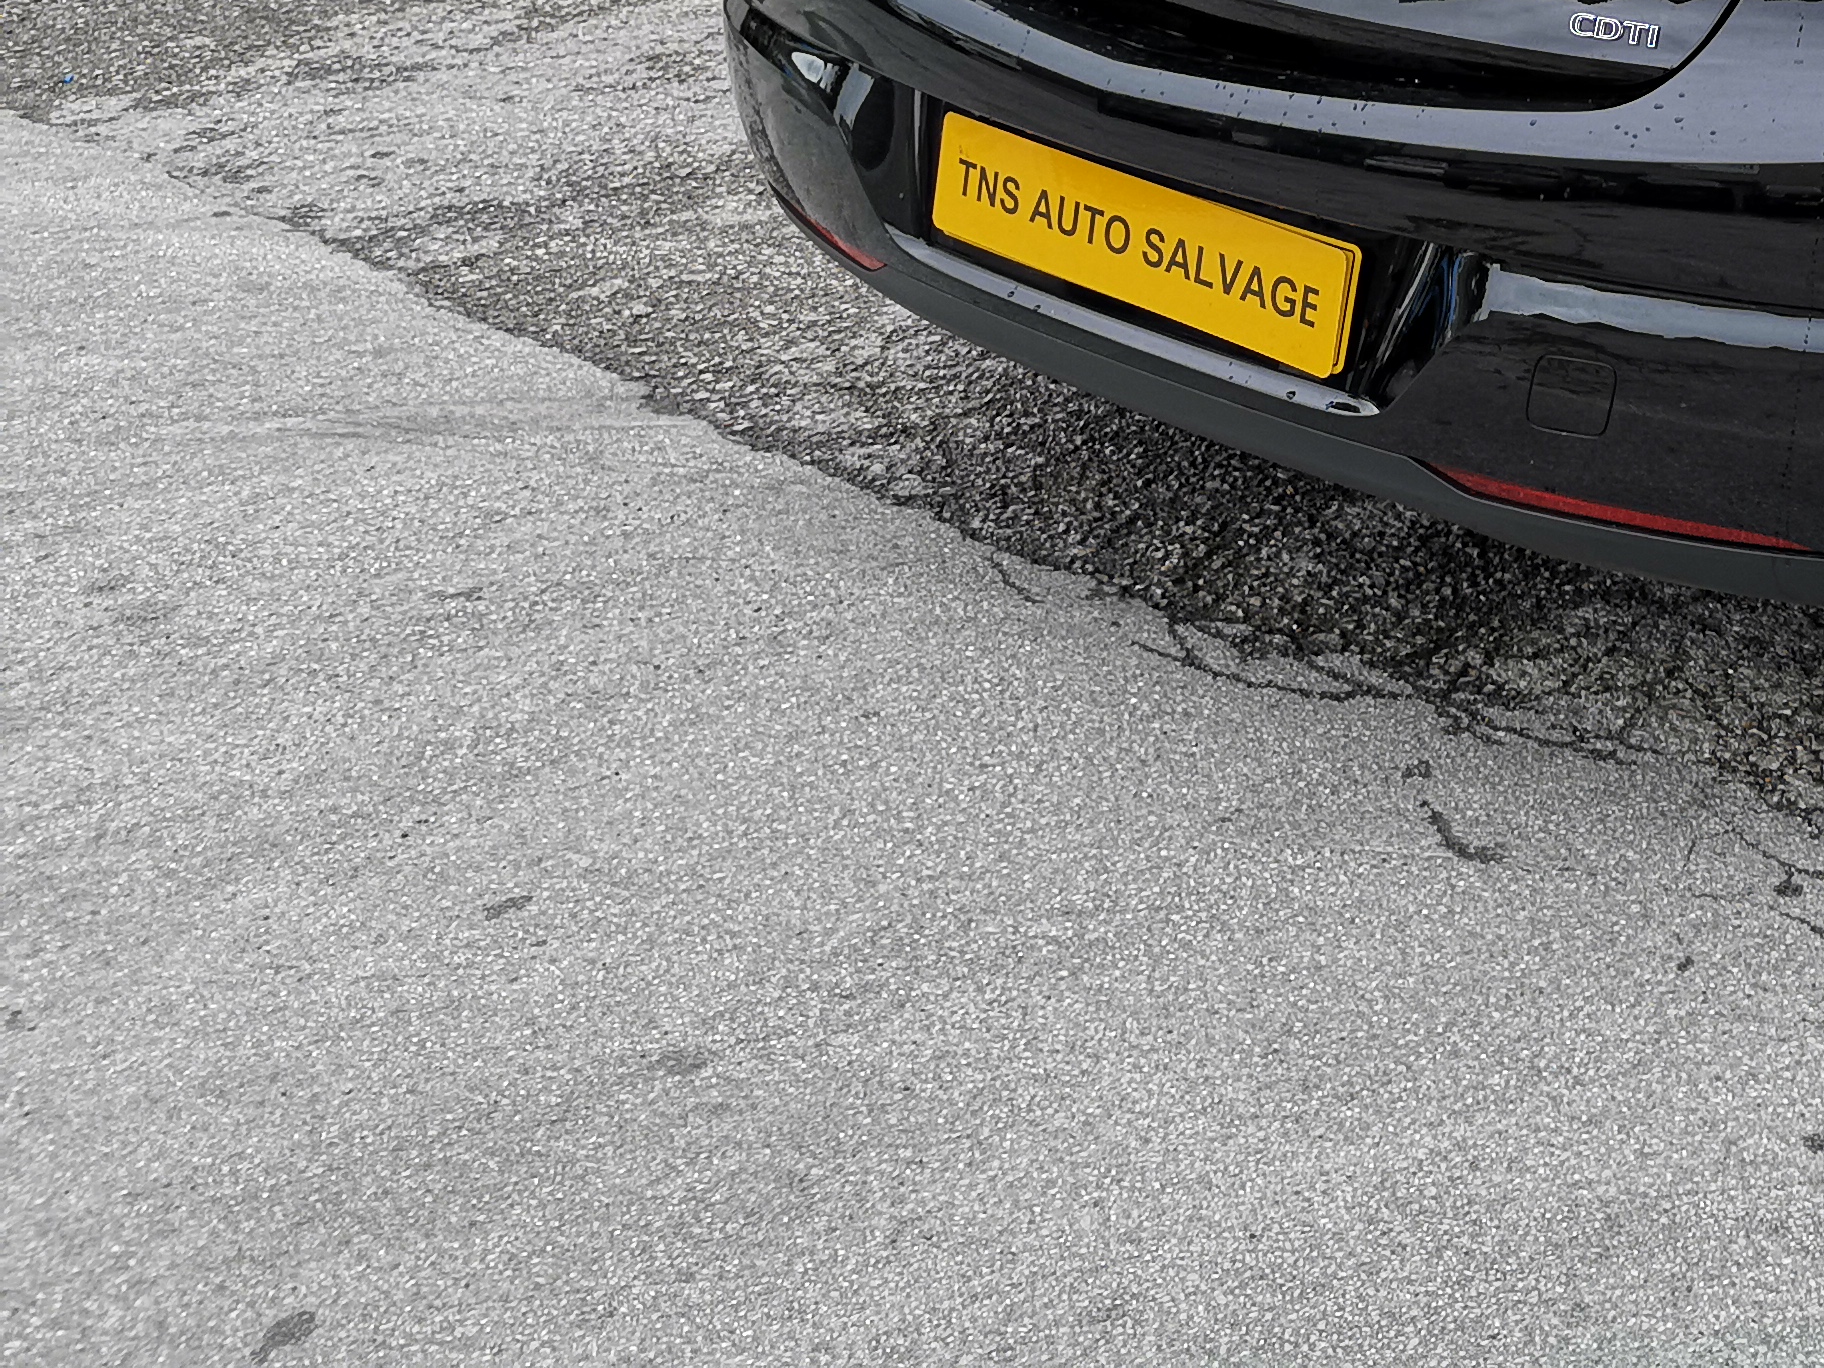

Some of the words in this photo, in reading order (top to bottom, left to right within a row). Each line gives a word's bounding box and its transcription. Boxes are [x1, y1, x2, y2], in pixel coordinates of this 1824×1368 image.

[1569, 13, 1661, 48] CDTI
[957, 157, 1020, 215] TNS
[1029, 189, 1132, 255] AUTO
[1141, 228, 1321, 329] SALVAGE
